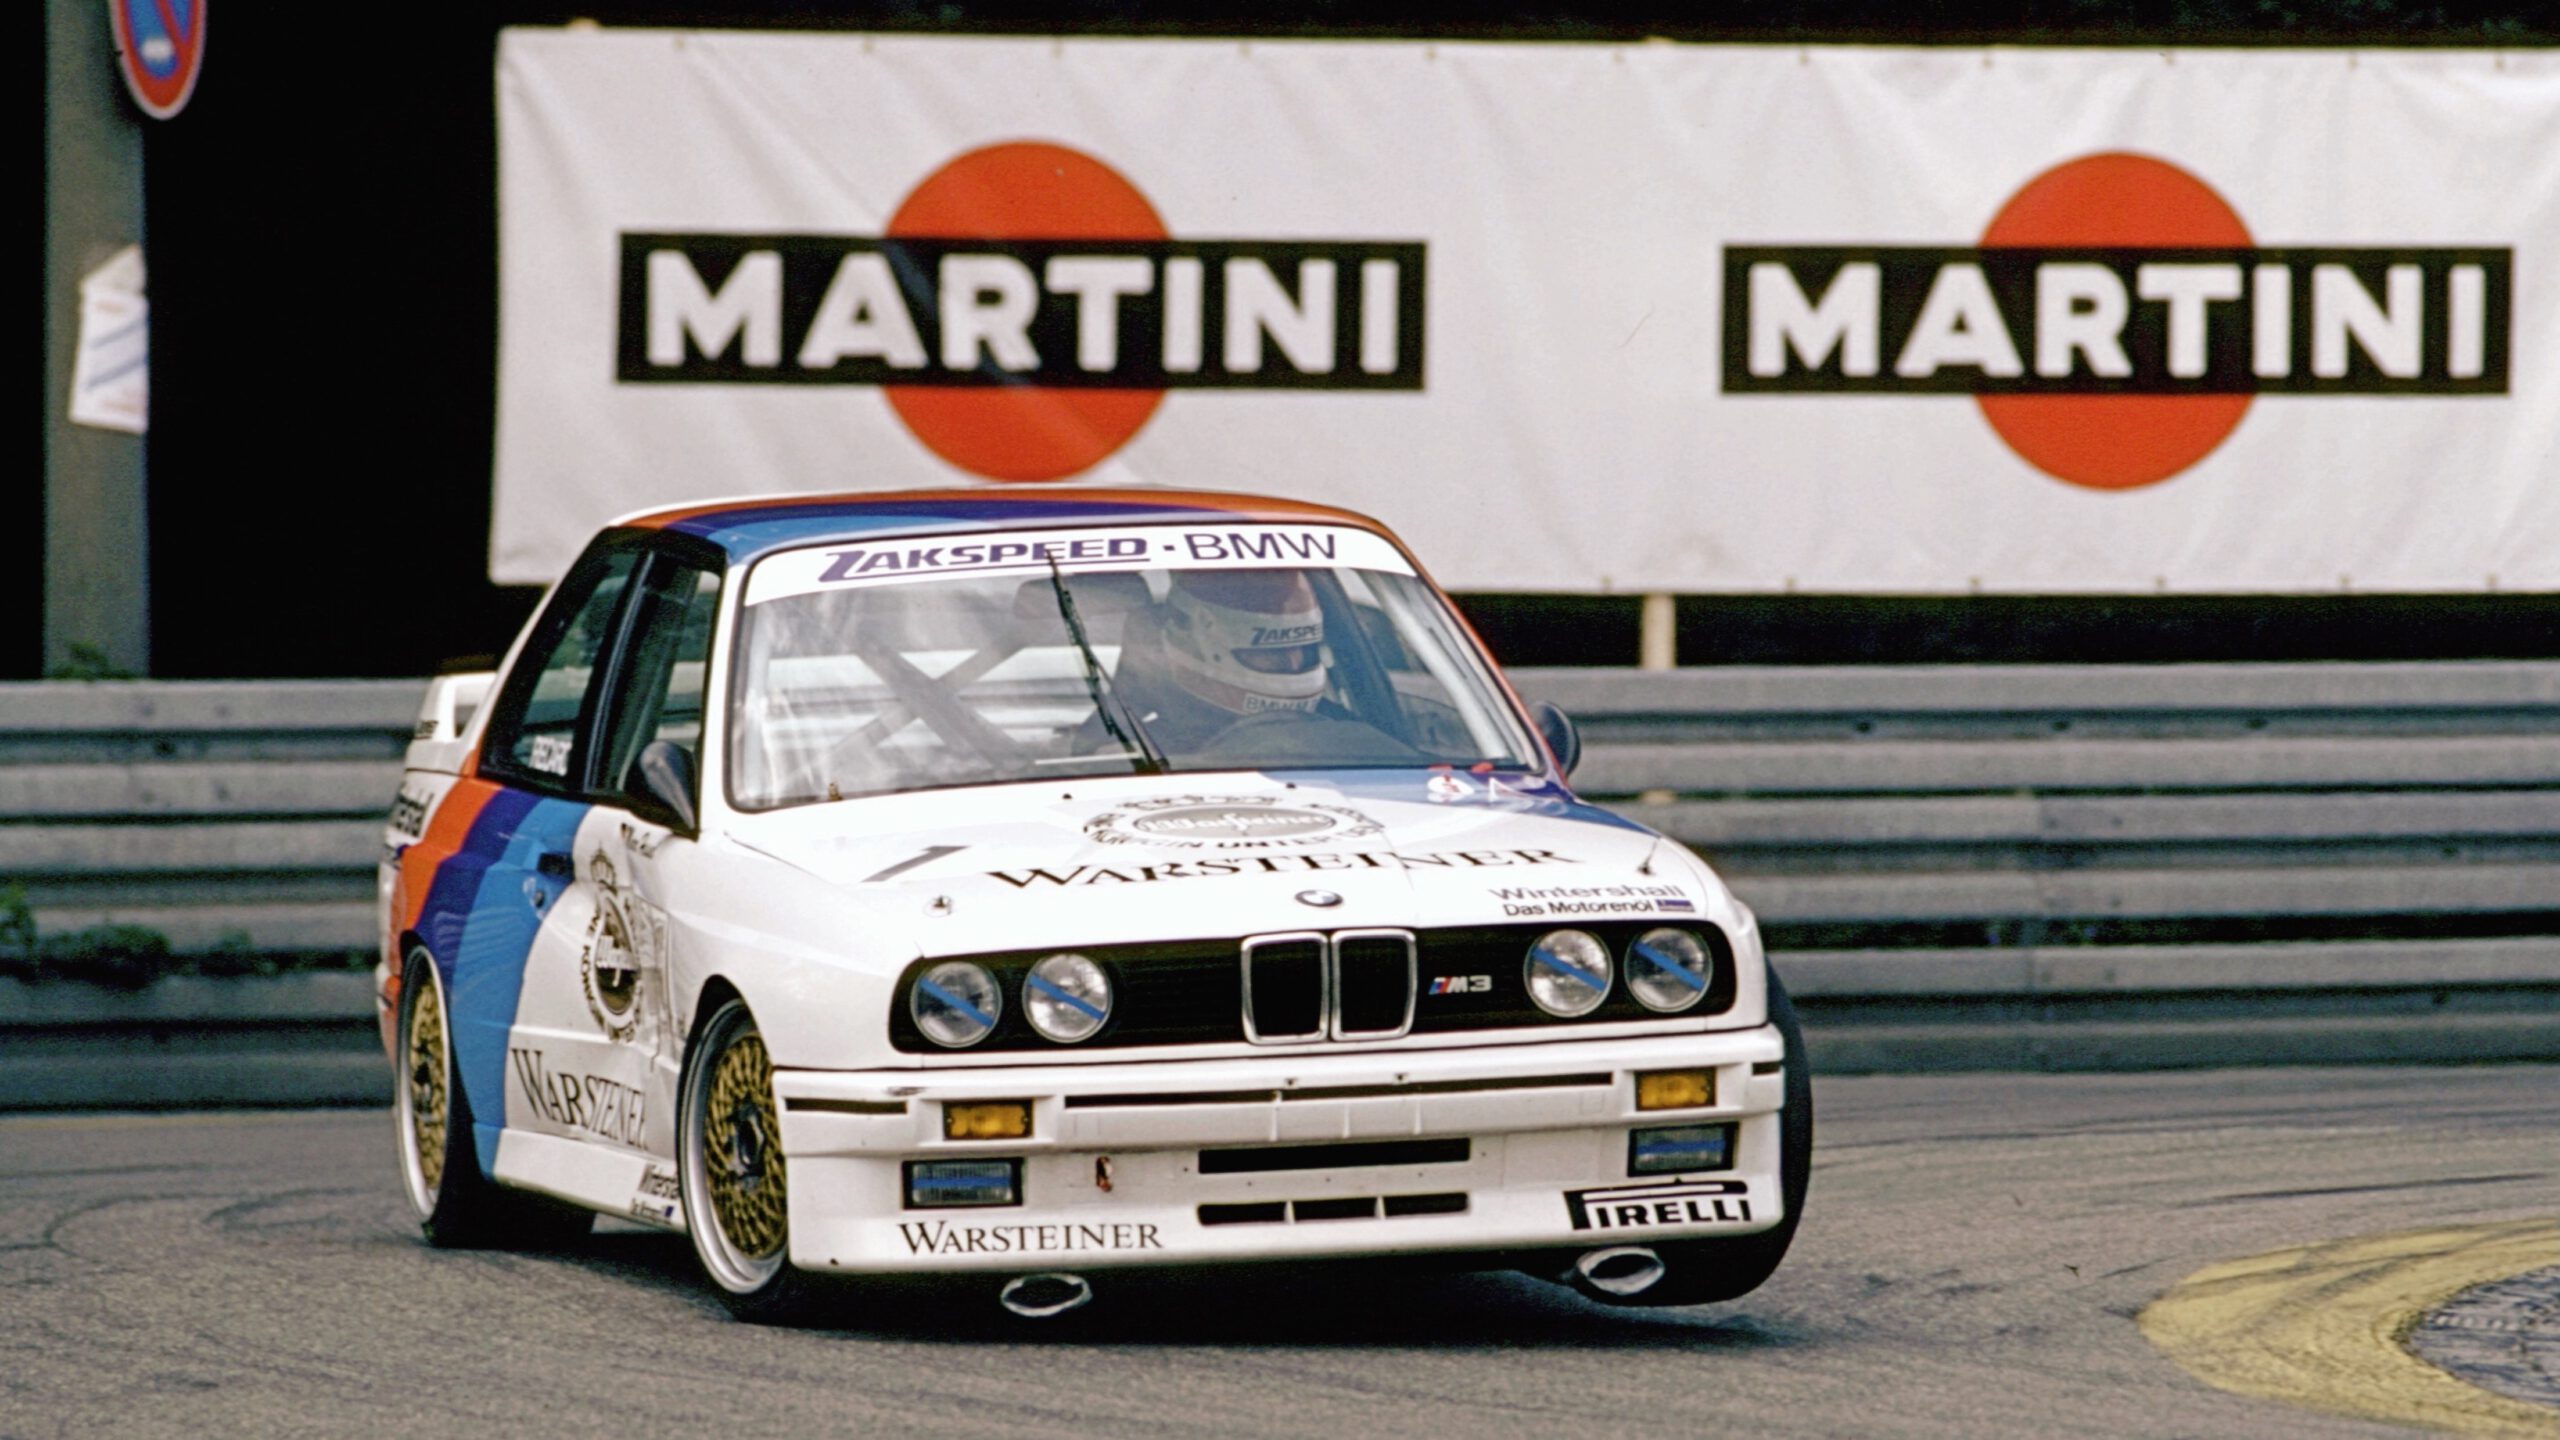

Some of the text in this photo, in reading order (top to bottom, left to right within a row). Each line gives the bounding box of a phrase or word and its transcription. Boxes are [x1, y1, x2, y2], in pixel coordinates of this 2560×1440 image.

[646, 248, 1400, 374] MARTINI
[1747, 261, 2487, 379] MARTINI
[818, 533, 1336, 582] ZAKSPEED BMW
[984, 849, 1585, 888] WARSTEINER
[1489, 884, 1686, 901] Wintershall
[1502, 903, 1545, 917] Das
[1446, 975, 1492, 993] M3
[1563, 1180, 1752, 1231] PIRELLI
[897, 1220, 1165, 1255] WARSTEINER
